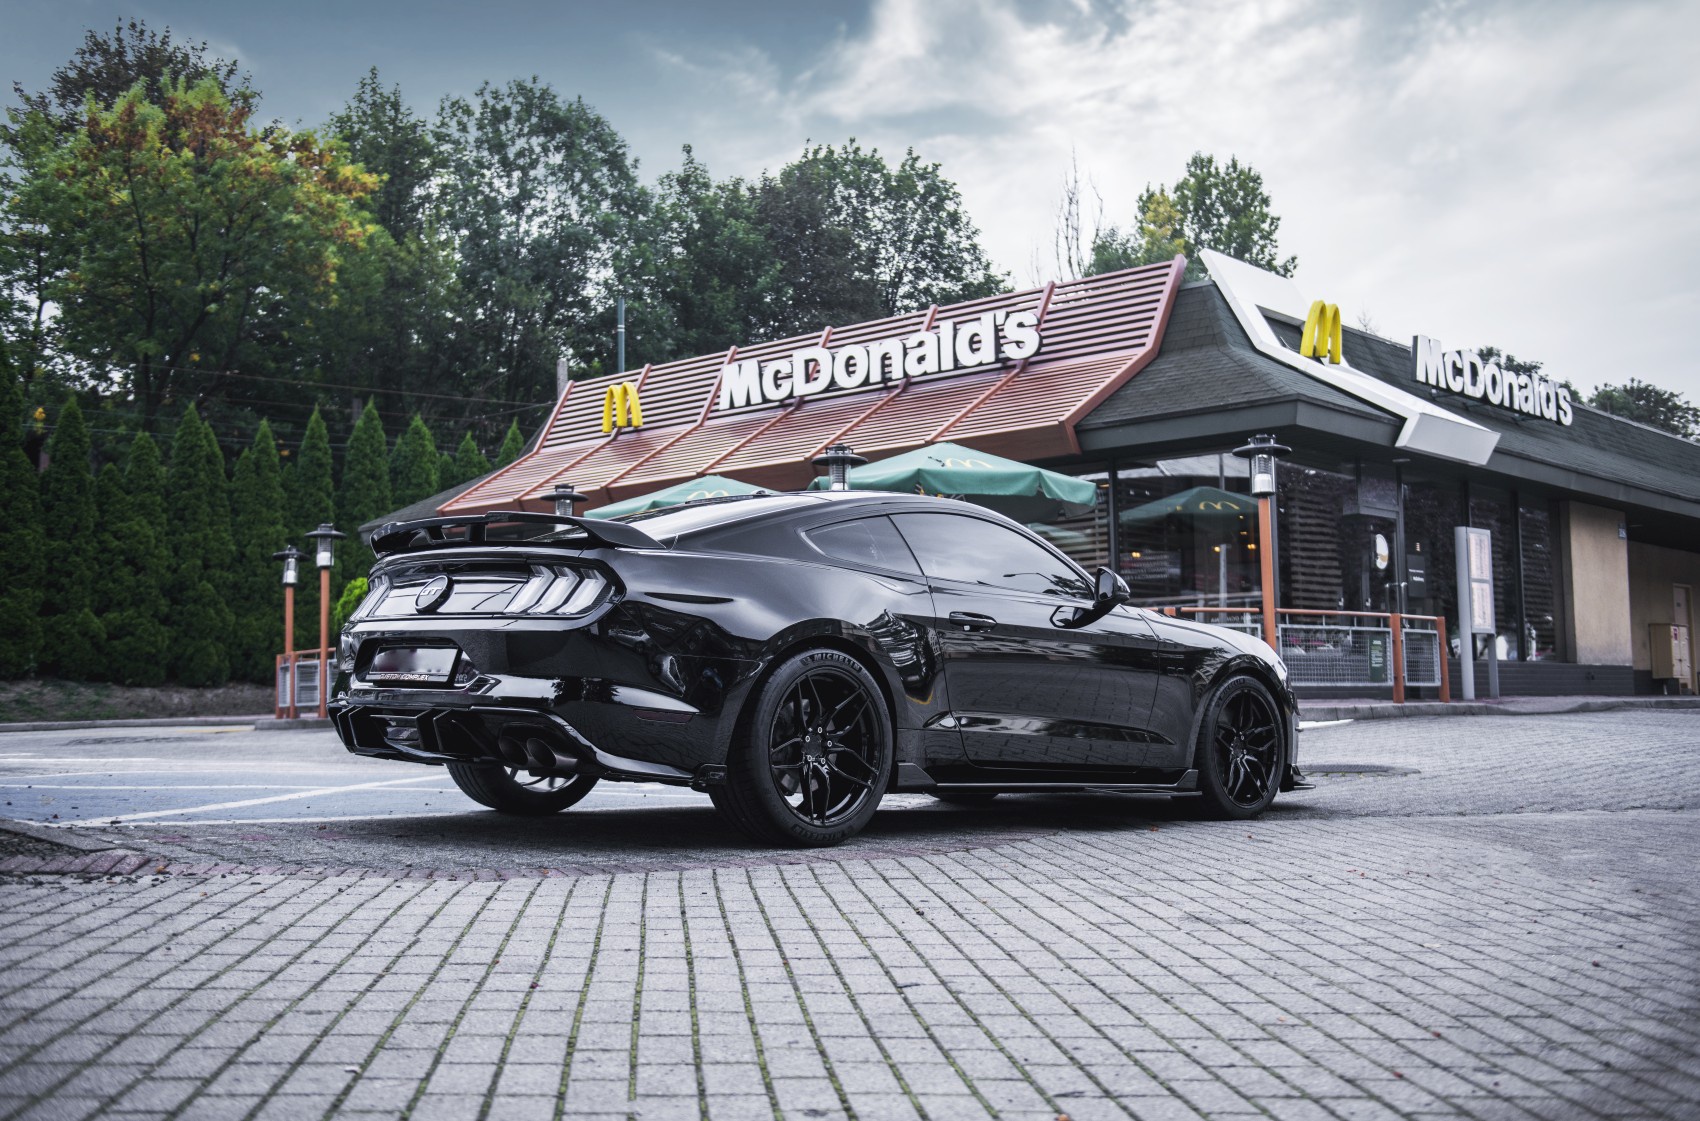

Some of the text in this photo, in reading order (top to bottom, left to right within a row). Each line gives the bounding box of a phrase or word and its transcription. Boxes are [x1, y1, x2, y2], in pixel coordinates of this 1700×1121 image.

[719, 310, 1041, 410] McDonald's
[1413, 334, 1573, 426] McDonald's
[814, 653, 861, 671] MICHELIN
